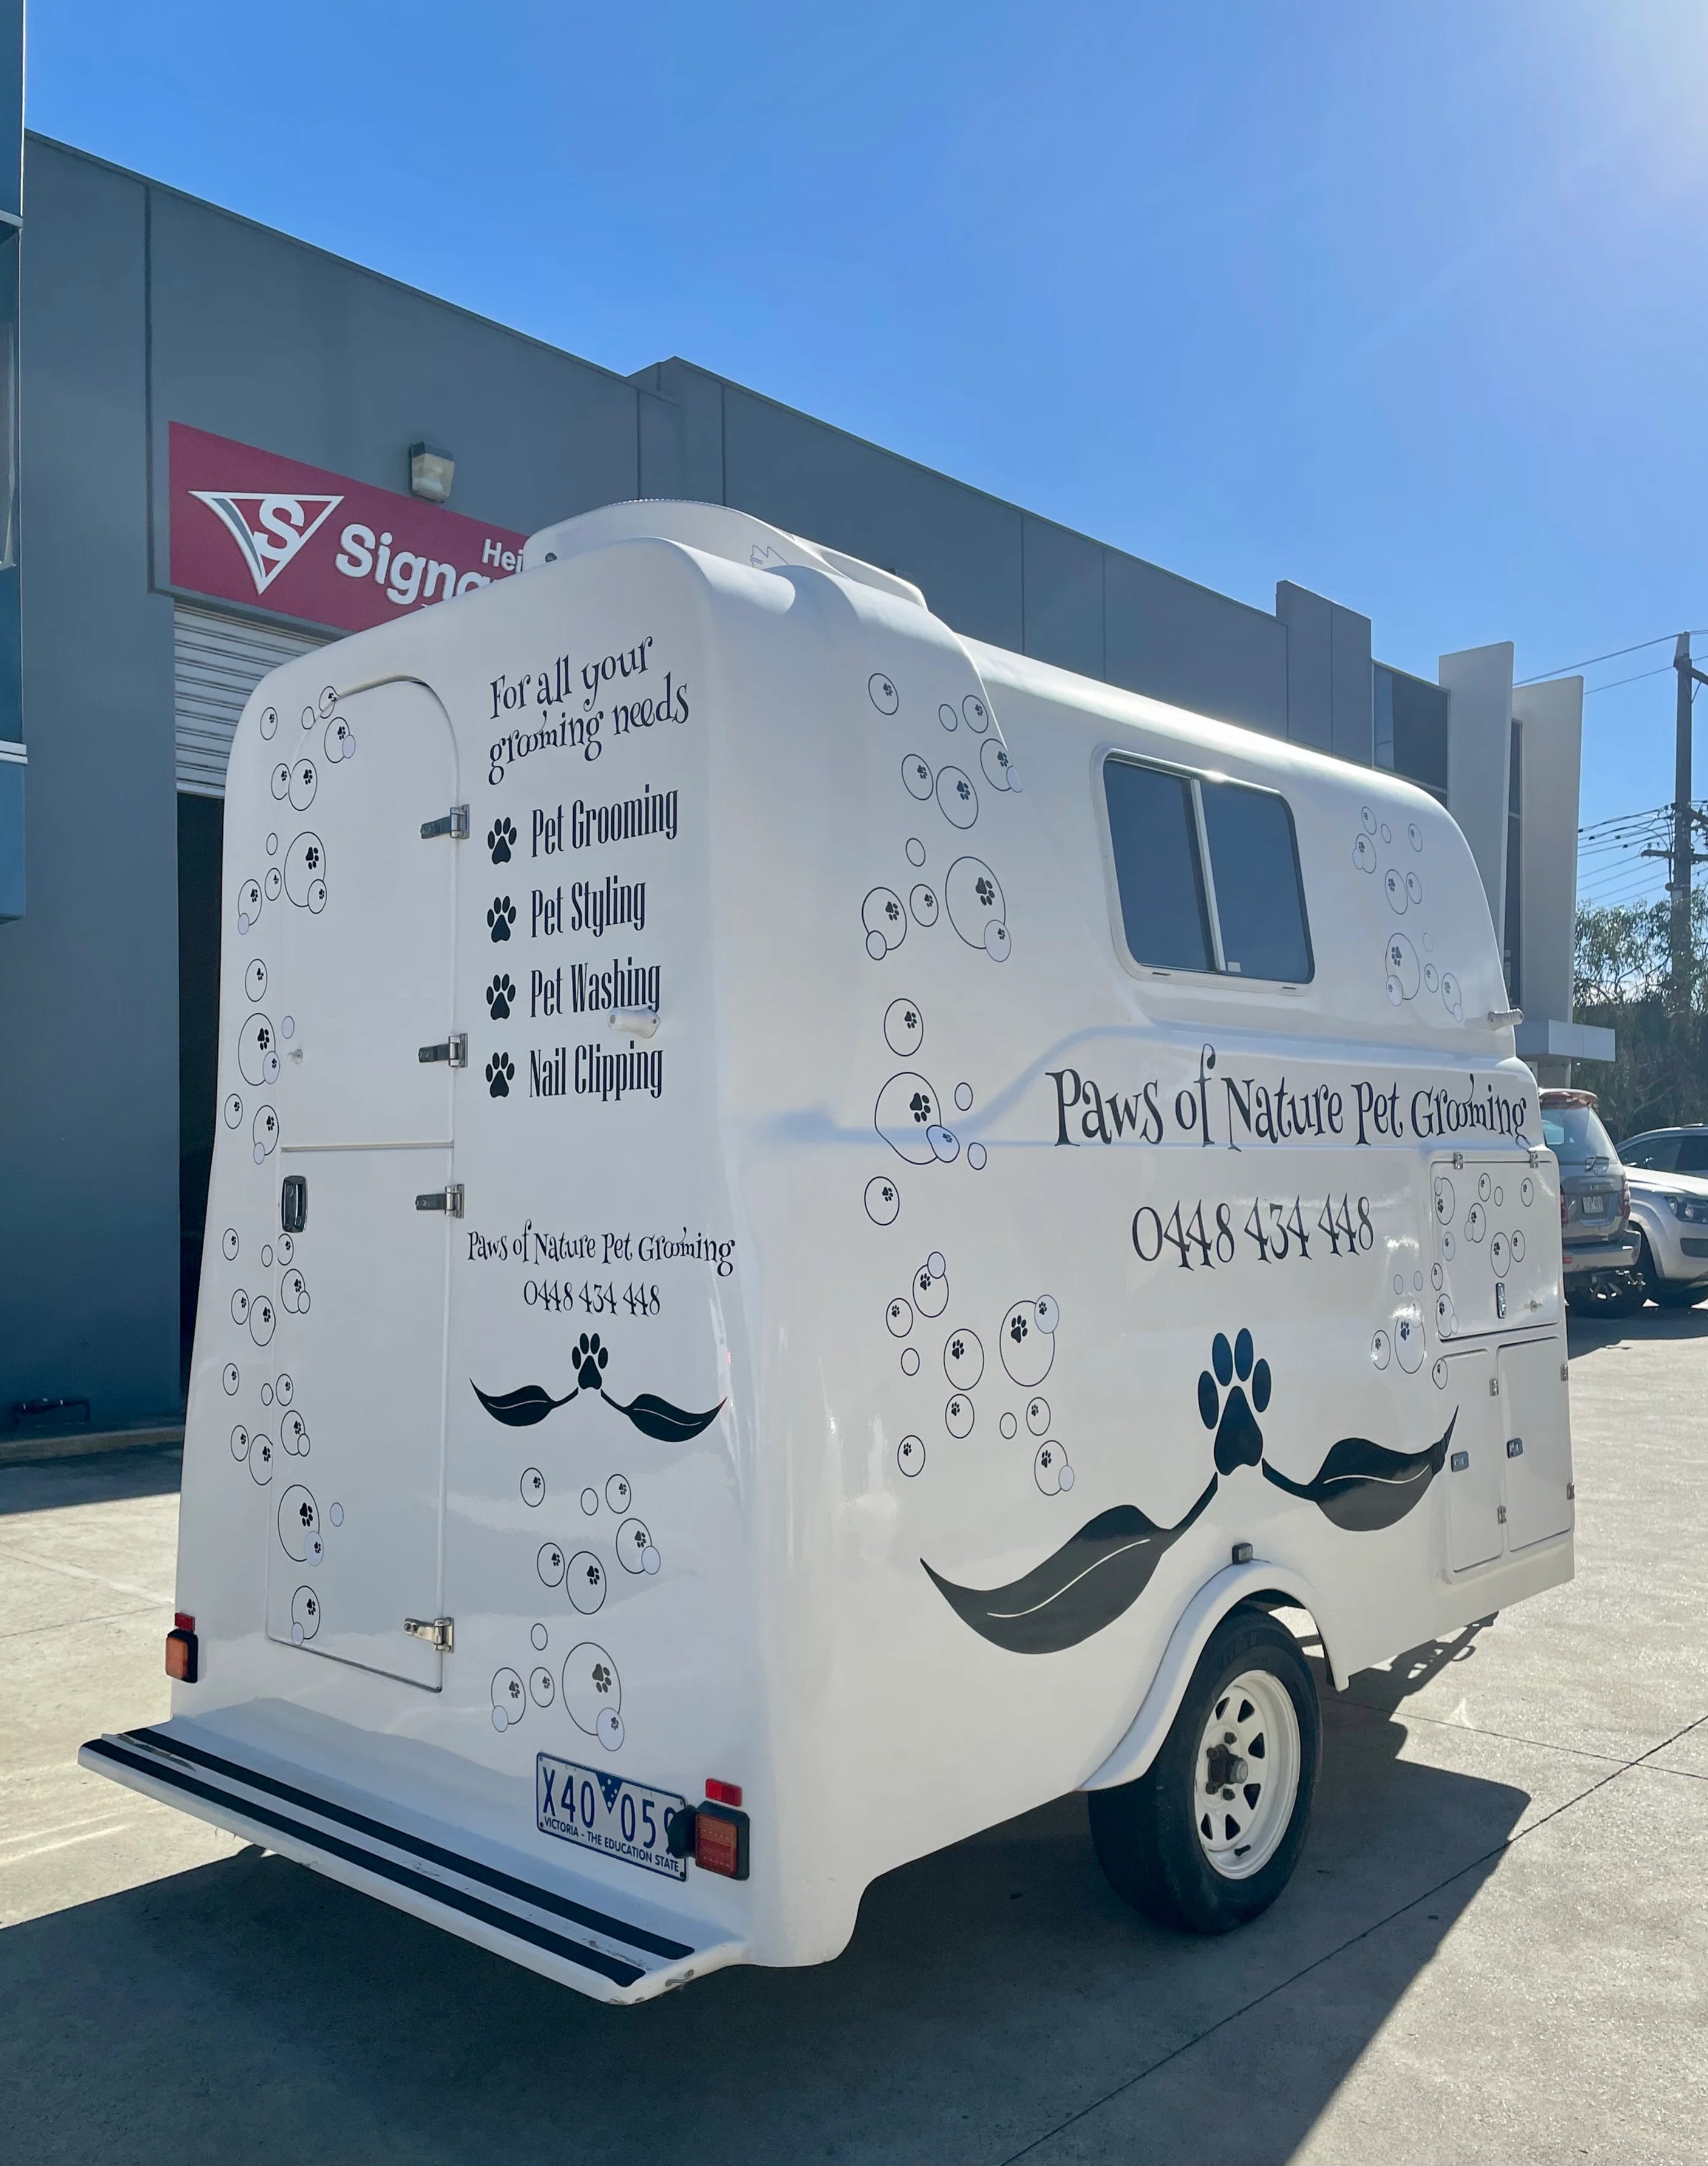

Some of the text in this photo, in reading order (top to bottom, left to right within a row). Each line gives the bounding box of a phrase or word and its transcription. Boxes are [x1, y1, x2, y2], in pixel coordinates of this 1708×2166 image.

[335, 523, 498, 605] Sign
[490, 636, 653, 719] For all your
[611, 672, 689, 735] needs
[531, 784, 678, 857] Pet Grooming
[531, 875, 646, 938] Pet Styling
[530, 957, 661, 1018] Pet Washing
[529, 1040, 664, 1102] Nail Clipping
[1045, 1068, 1163, 1146] Paws
[1175, 1043, 1216, 1148] of
[1220, 1075, 1342, 1152] Nature
[1351, 1081, 1404, 1146] Pet
[468, 1231, 508, 1261] Paws
[513, 1219, 532, 1263] of
[534, 1231, 596, 1265] Nature
[601, 1232, 633, 1265] Pet
[1132, 1193, 1374, 1271] 0448 434 448
[523, 1279, 660, 1317] 0448 434 448
[542, 1766, 595, 1828] X40
[544, 1816, 579, 1837] VICTORIA
[587, 1831, 602, 1845] THE
[605, 1837, 652, 1864] EDUCATION
[655, 1855, 679, 1873] STATE
